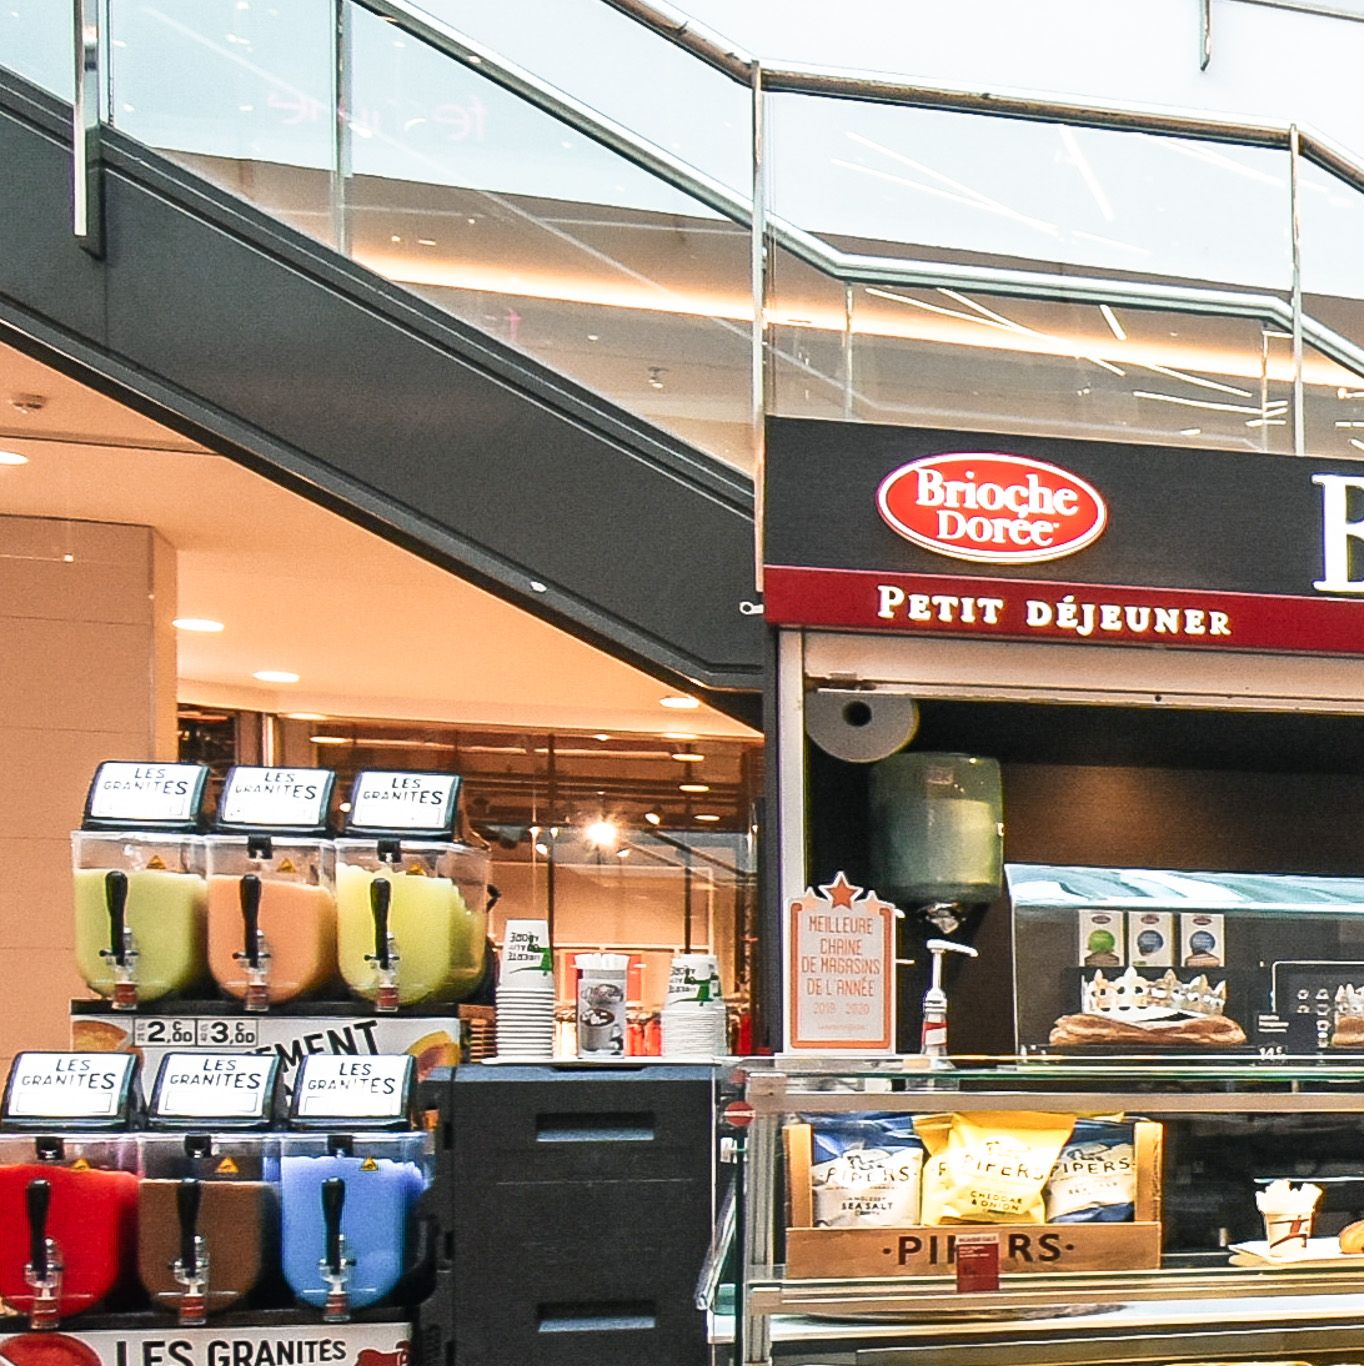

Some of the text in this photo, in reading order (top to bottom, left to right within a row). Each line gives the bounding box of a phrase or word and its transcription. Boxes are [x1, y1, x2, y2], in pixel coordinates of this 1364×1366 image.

[916, 468, 1079, 516] Brioche
[936, 509, 1054, 547] Dorée
[135, 768, 165, 780] LES
[264, 771, 295, 783] LES
[391, 777, 421, 789] LES
[809, 916, 873, 934] MEILLEURE
[802, 958, 880, 975] DE MAGASINS
[807, 979, 822, 996] DE
[56, 1059, 91, 1072] LES
[203, 1058, 237, 1071] LES
[339, 1062, 371, 1076] LES
[826, 1166, 910, 1183] PIPERS
[841, 1202, 893, 1210] SEA SALT
[898, 1232, 1061, 1265] PIRS
